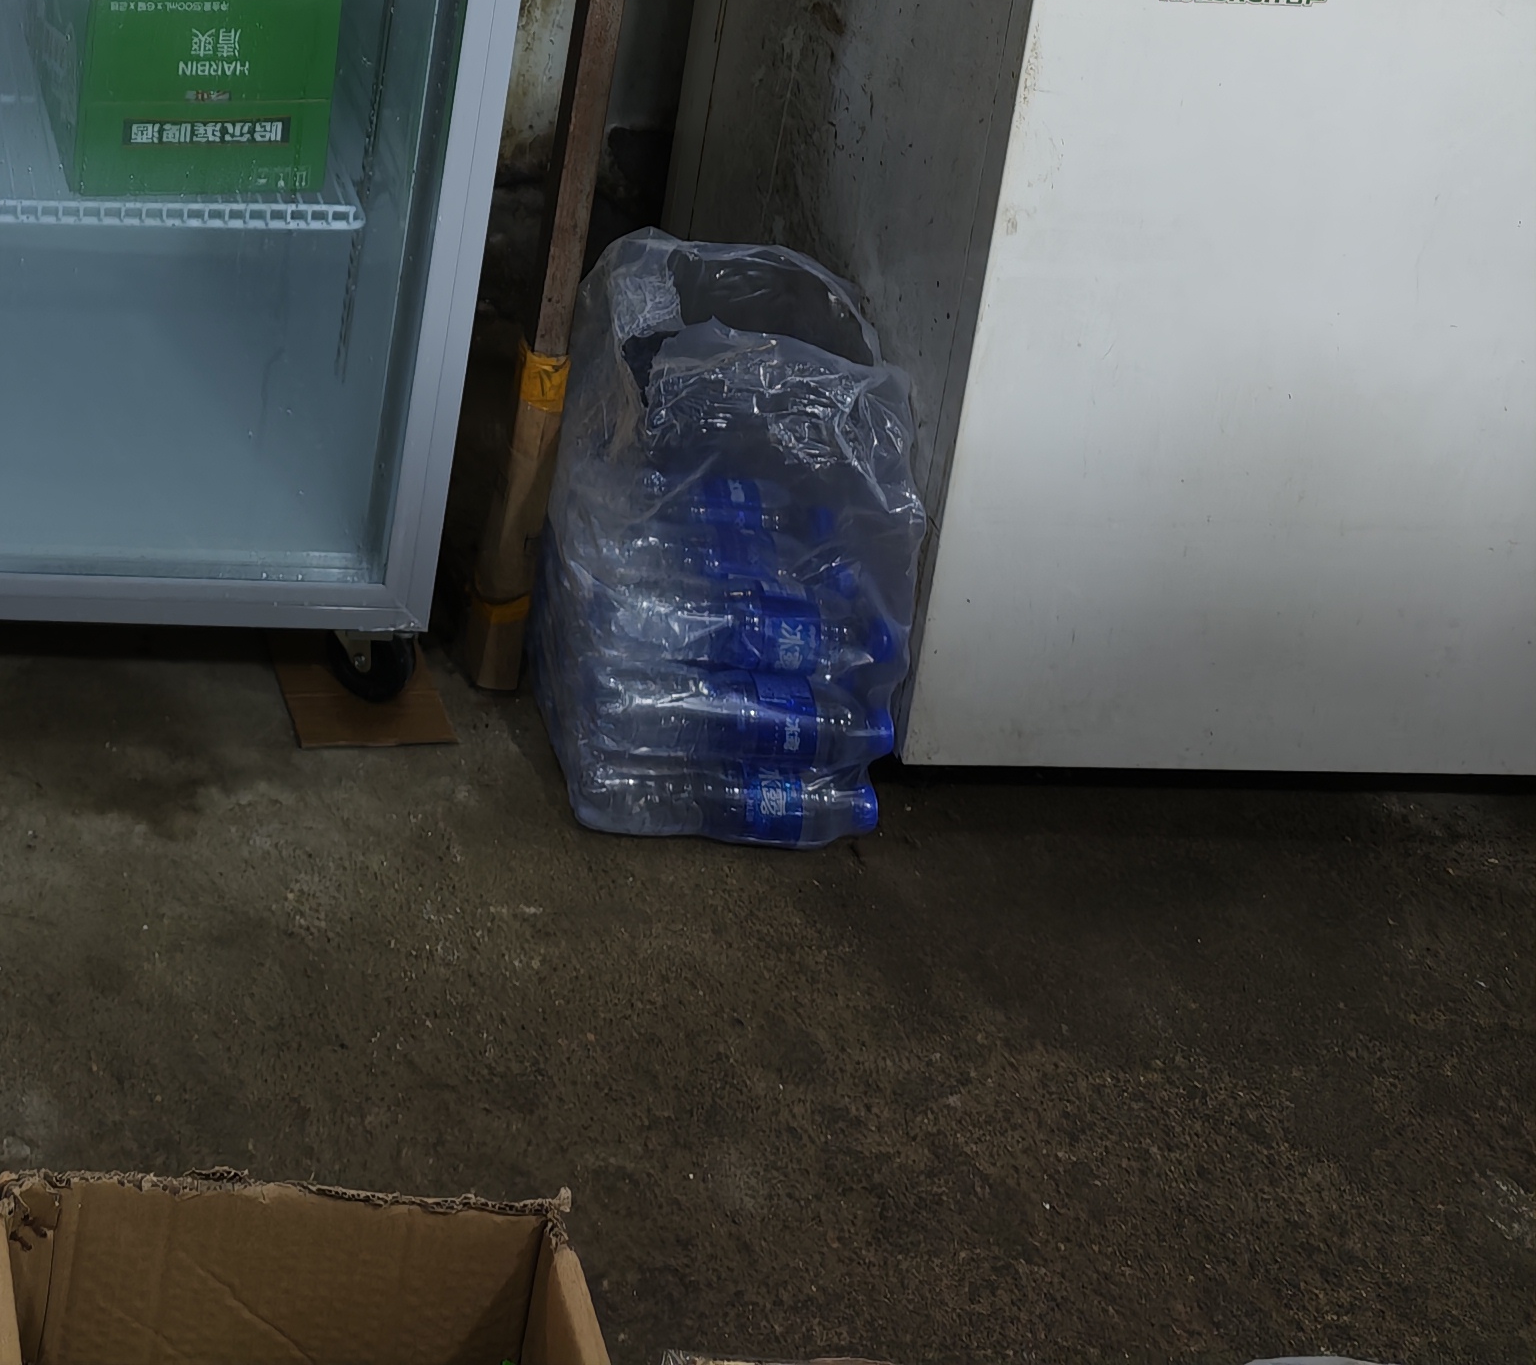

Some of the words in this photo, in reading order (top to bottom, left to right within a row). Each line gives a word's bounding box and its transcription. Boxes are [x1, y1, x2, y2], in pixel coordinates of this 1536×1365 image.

[191, 27, 242, 58] 清爽
[178, 60, 250, 77] HARBIN
[130, 120, 284, 145] 哈尔滨啤酒
